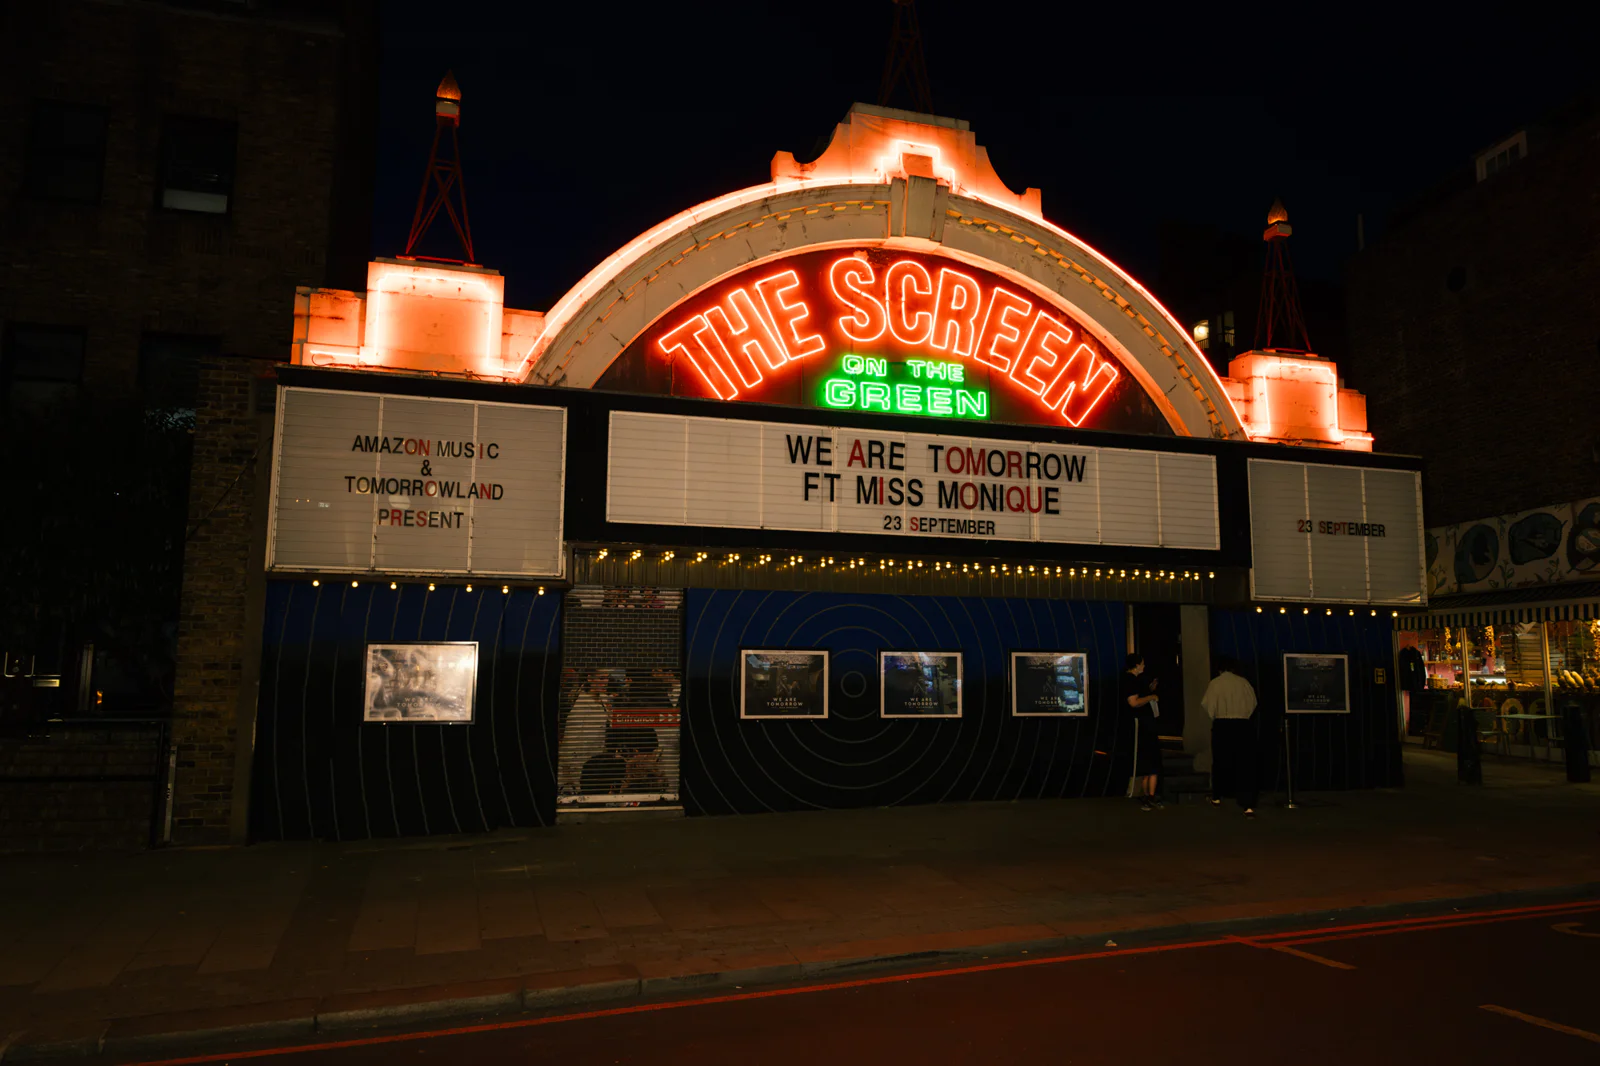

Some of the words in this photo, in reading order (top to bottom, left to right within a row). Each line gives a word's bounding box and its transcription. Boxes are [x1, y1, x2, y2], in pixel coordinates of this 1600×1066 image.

[658, 269, 826, 400] THE
[830, 257, 1118, 427] SCREEN
[842, 354, 887, 378] ON
[906, 359, 965, 383] THE
[825, 379, 988, 418] GREEN
[352, 435, 430, 456] AMAZON
[437, 440, 499, 459] MUSIC
[786, 434, 832, 466] WE
[847, 439, 906, 471] ARE
[928, 444, 1086, 482] TOMORROW
[420, 459, 432, 476] &
[344, 476, 504, 500] TOMORROWLAND
[804, 472, 841, 502] FT
[856, 475, 924, 507] MISS
[938, 480, 1060, 515] MONIQUE
[378, 508, 464, 529] PRESENT
[883, 515, 902, 531] 23
[910, 516, 995, 536] SEPTEMBER
[1297, 519, 1313, 533] 23
[1319, 521, 1386, 537] SEPTEMBER
